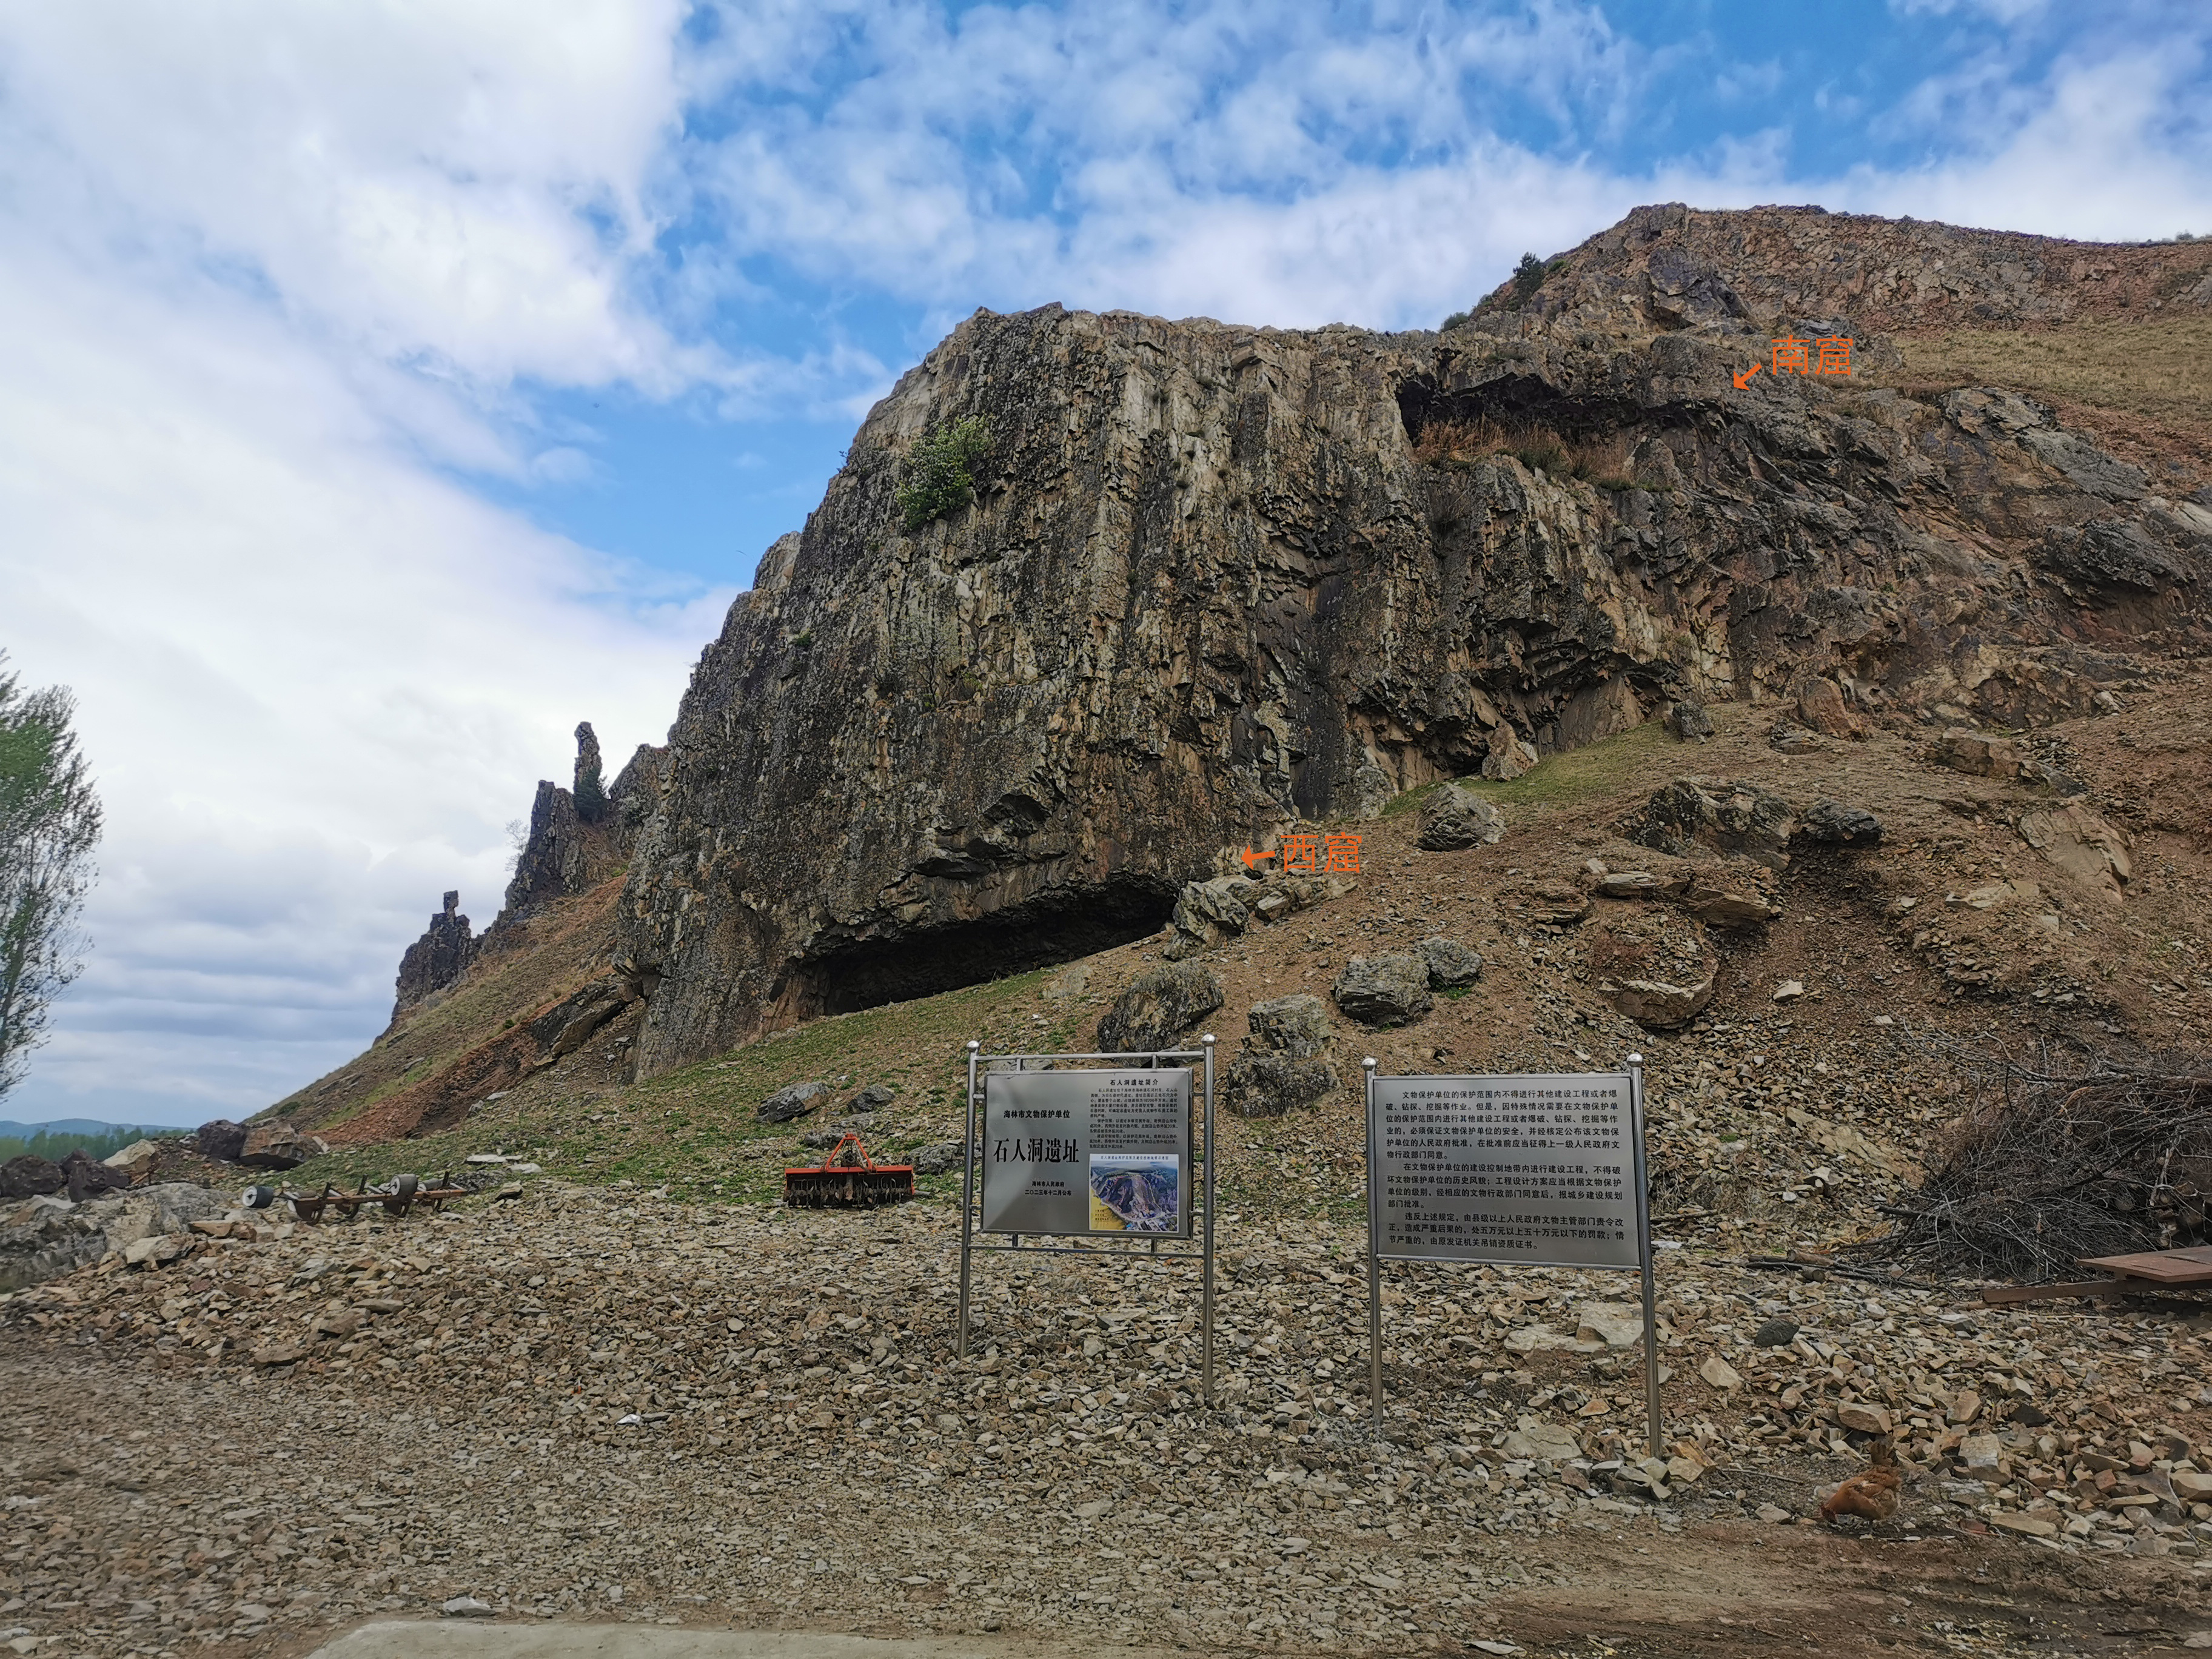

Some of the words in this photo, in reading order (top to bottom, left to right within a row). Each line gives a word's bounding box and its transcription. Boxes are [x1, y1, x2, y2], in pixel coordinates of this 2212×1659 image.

[1403, 1090, 1617, 1099] 文物保护单位的保护范围内不得进行其他建设工程或者爆
[1386, 1114, 1618, 1123] 位的保护范围内进行其他建设工程或者爆破、钻探、挖掘等作
[1387, 1127, 1620, 1136] 业的，必须保证文物保护单位的安全，并经核定公布该文物保
[1387, 1139, 1620, 1149] 护单位的人民政府批准，在批准前应当征得上一级人民政府文
[994, 1138, 1079, 1162] 石人洞遗址
[1387, 1151, 1448, 1159] 物行政部门同意。
[1404, 1162, 1621, 1175] 在文物保护单位的建设控制地带内进行建设工程，不得破
[1387, 1176, 1621, 1187] 坏文物保护单位的历史风貌；工程设计方案应当根据文物保护
[1388, 1199, 1425, 1208] 部门批准。
[1406, 1213, 1624, 1227] 违反上述规定，由县级以上人民政府文物主管部门责令改
[1389, 1236, 1538, 1250] 节严重的，由原发证机关吊销资质证书。
